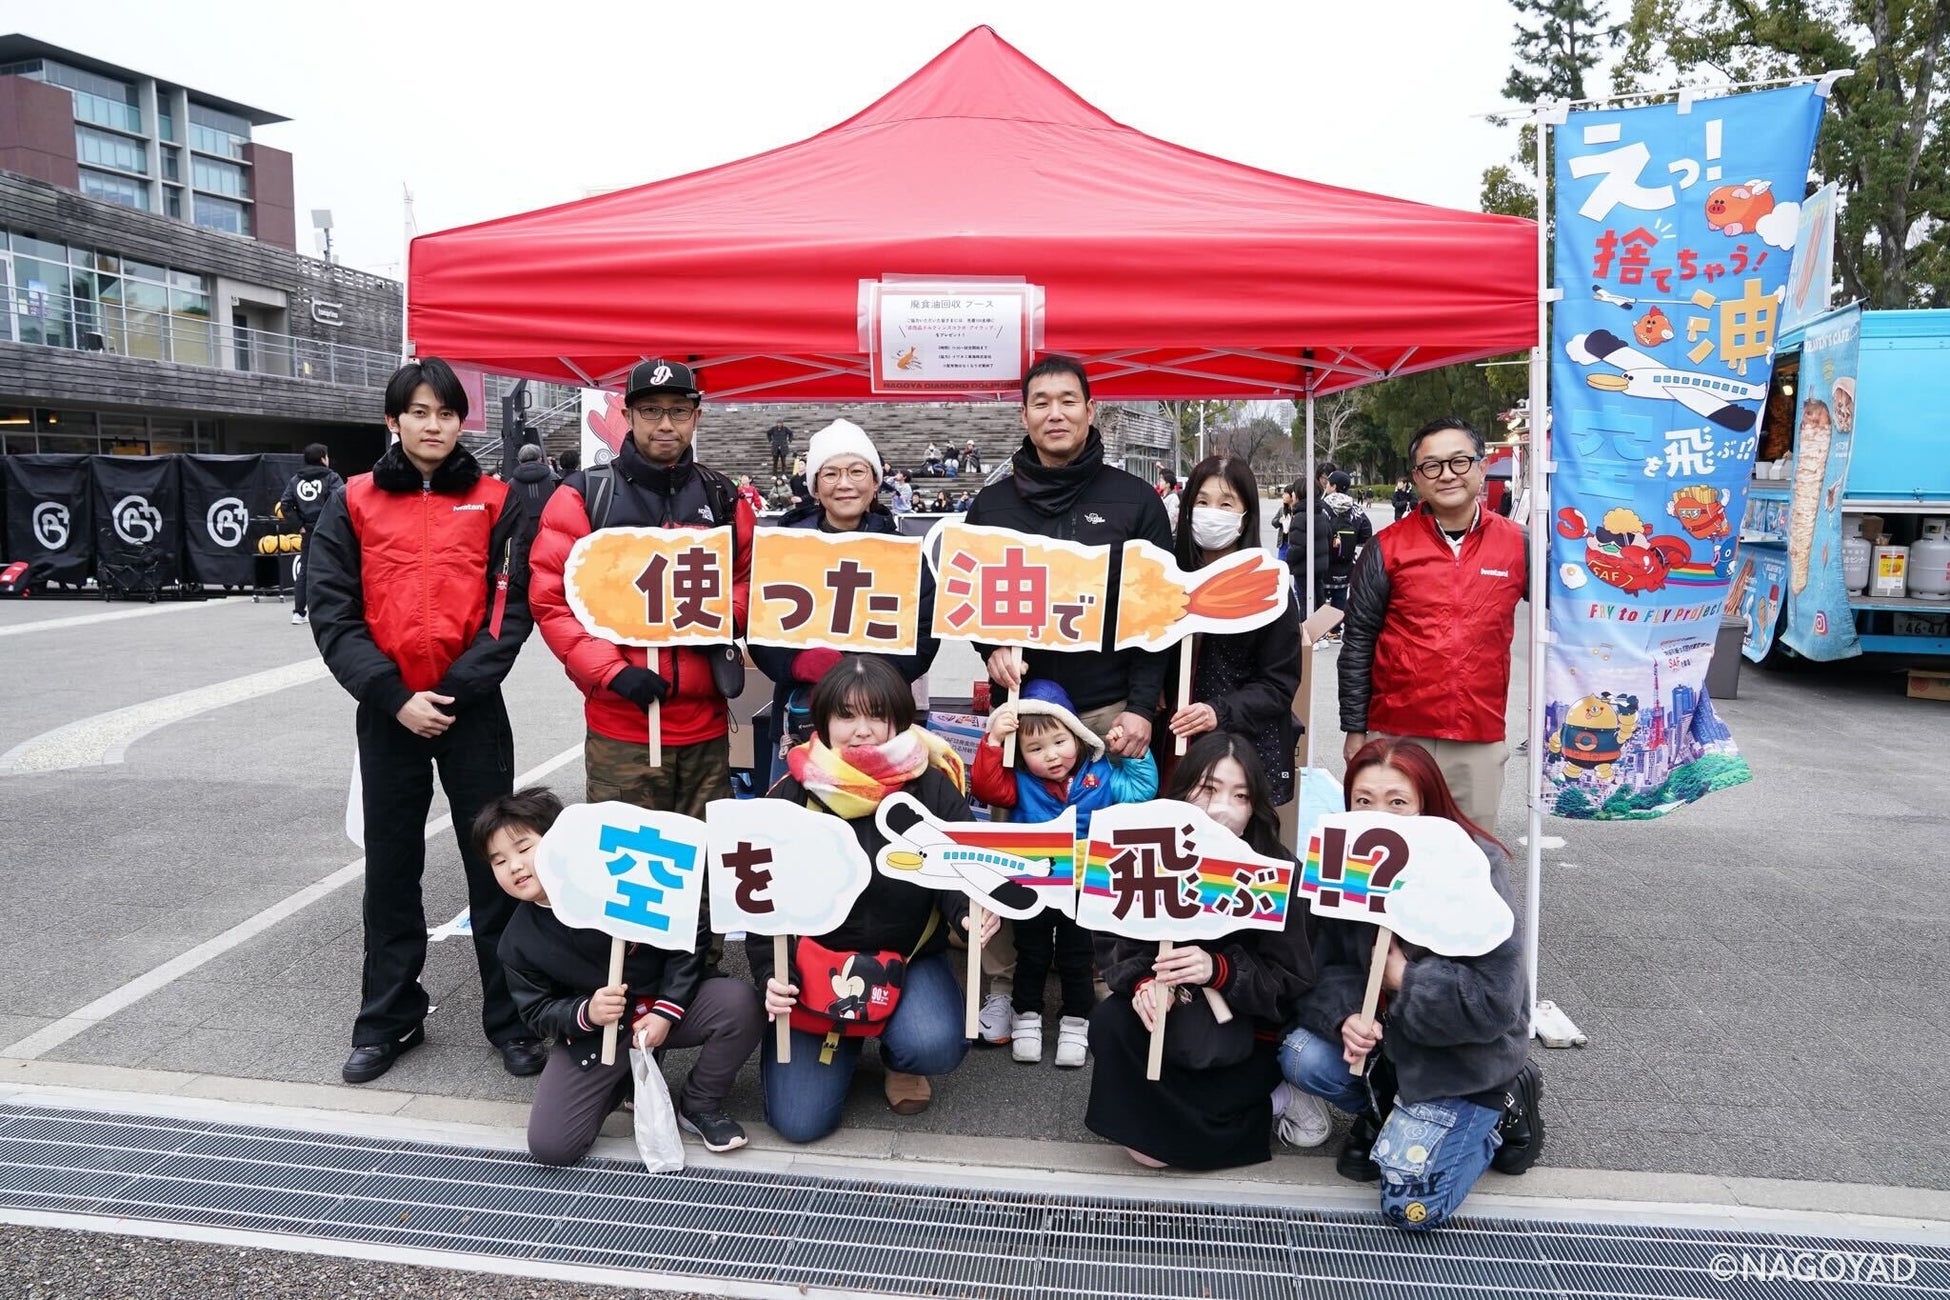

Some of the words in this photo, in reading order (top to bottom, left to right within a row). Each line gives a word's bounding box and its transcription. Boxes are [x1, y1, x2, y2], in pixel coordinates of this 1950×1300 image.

[1569, 119, 1723, 222] えっ!
[1592, 226, 1768, 293] 捨てちゃう!
[910, 299, 961, 309] 廃食油回収
[1686, 278, 1779, 372] 油
[635, 547, 722, 630] 使
[763, 560, 899, 640] った
[946, 548, 1095, 640] 油で
[1589, 604, 1615, 619] FRY
[1619, 607, 1639, 621] to
[1643, 609, 1672, 623] FLY
[1593, 566, 1620, 582] SAF
[598, 824, 697, 931] 空
[721, 841, 775, 914] を
[1106, 823, 1278, 920] 飛ぶ
[1318, 827, 1410, 914] !?
